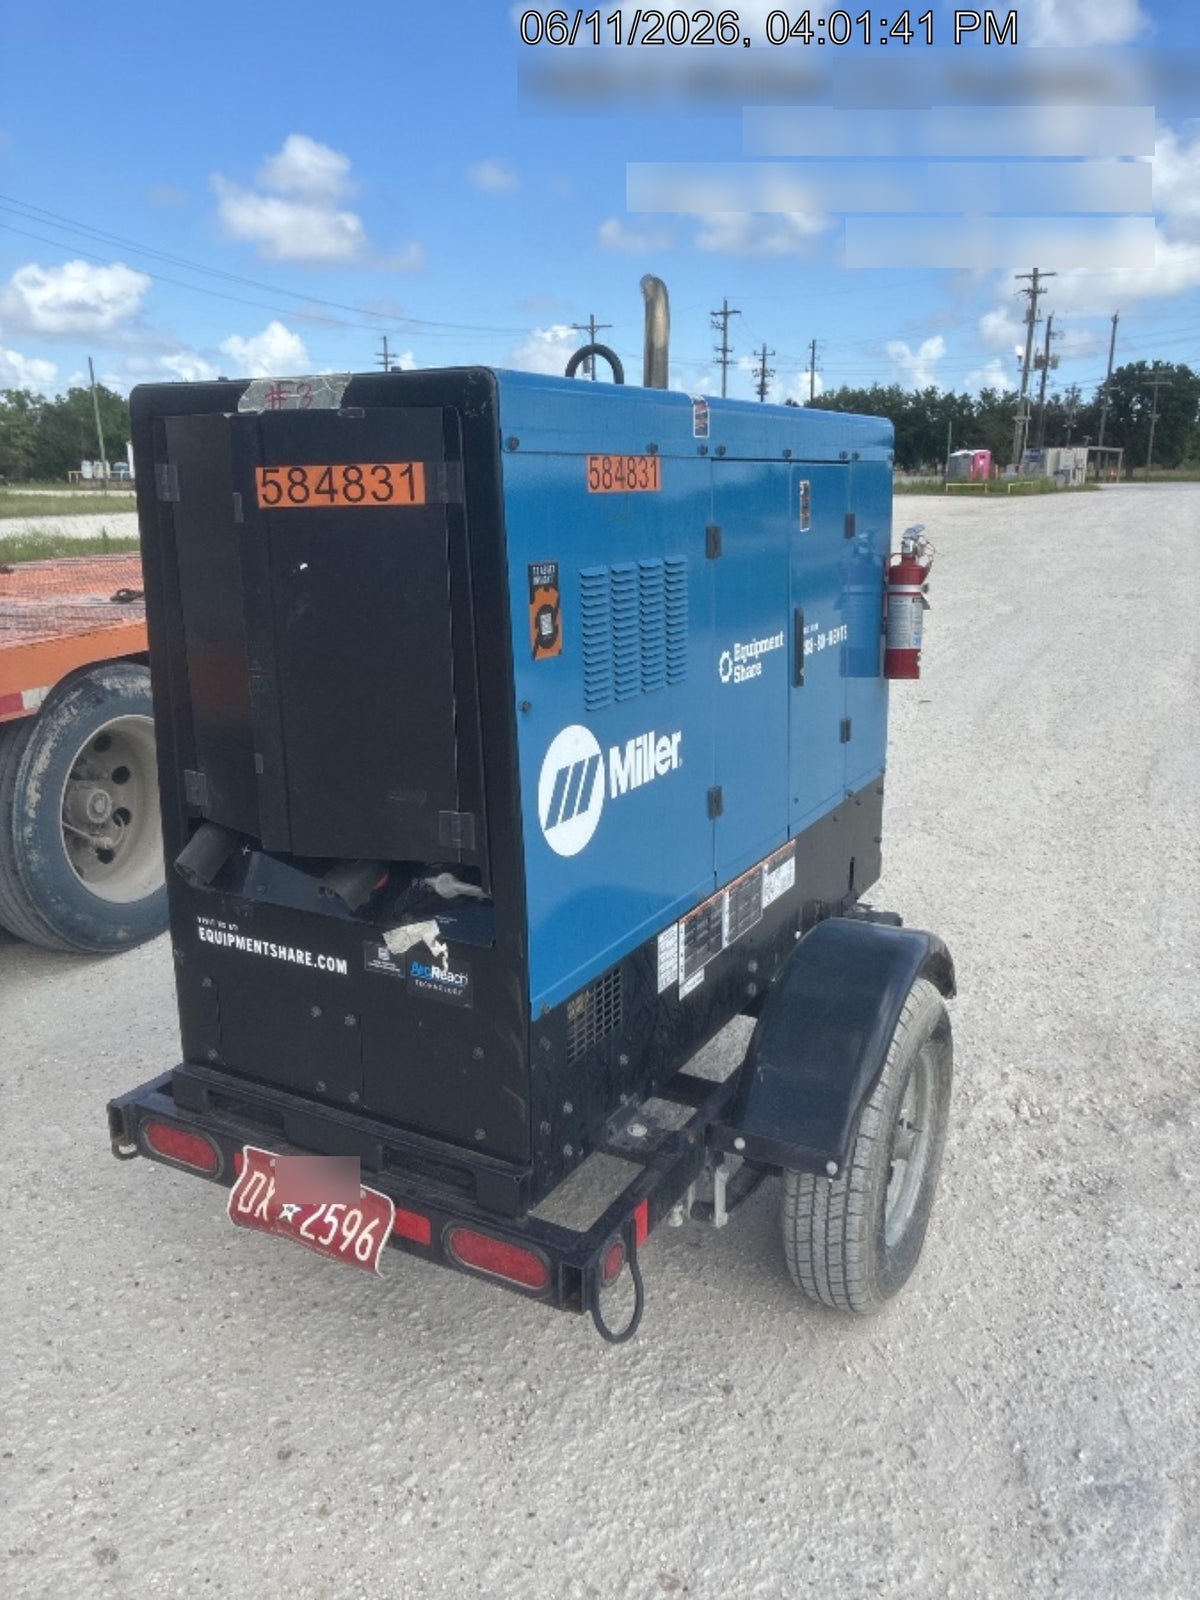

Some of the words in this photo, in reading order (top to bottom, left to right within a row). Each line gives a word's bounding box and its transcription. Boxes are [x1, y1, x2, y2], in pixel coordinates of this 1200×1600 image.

[261, 463, 416, 505] 584831
[589, 456, 659, 491] 584831
[733, 630, 784, 663] Equipment
[733, 662, 762, 684] Share
[609, 730, 682, 799] Miller
[198, 926, 348, 976] EQUIPMENTSHARE.COM
[299, 1203, 381, 1262] 2596
